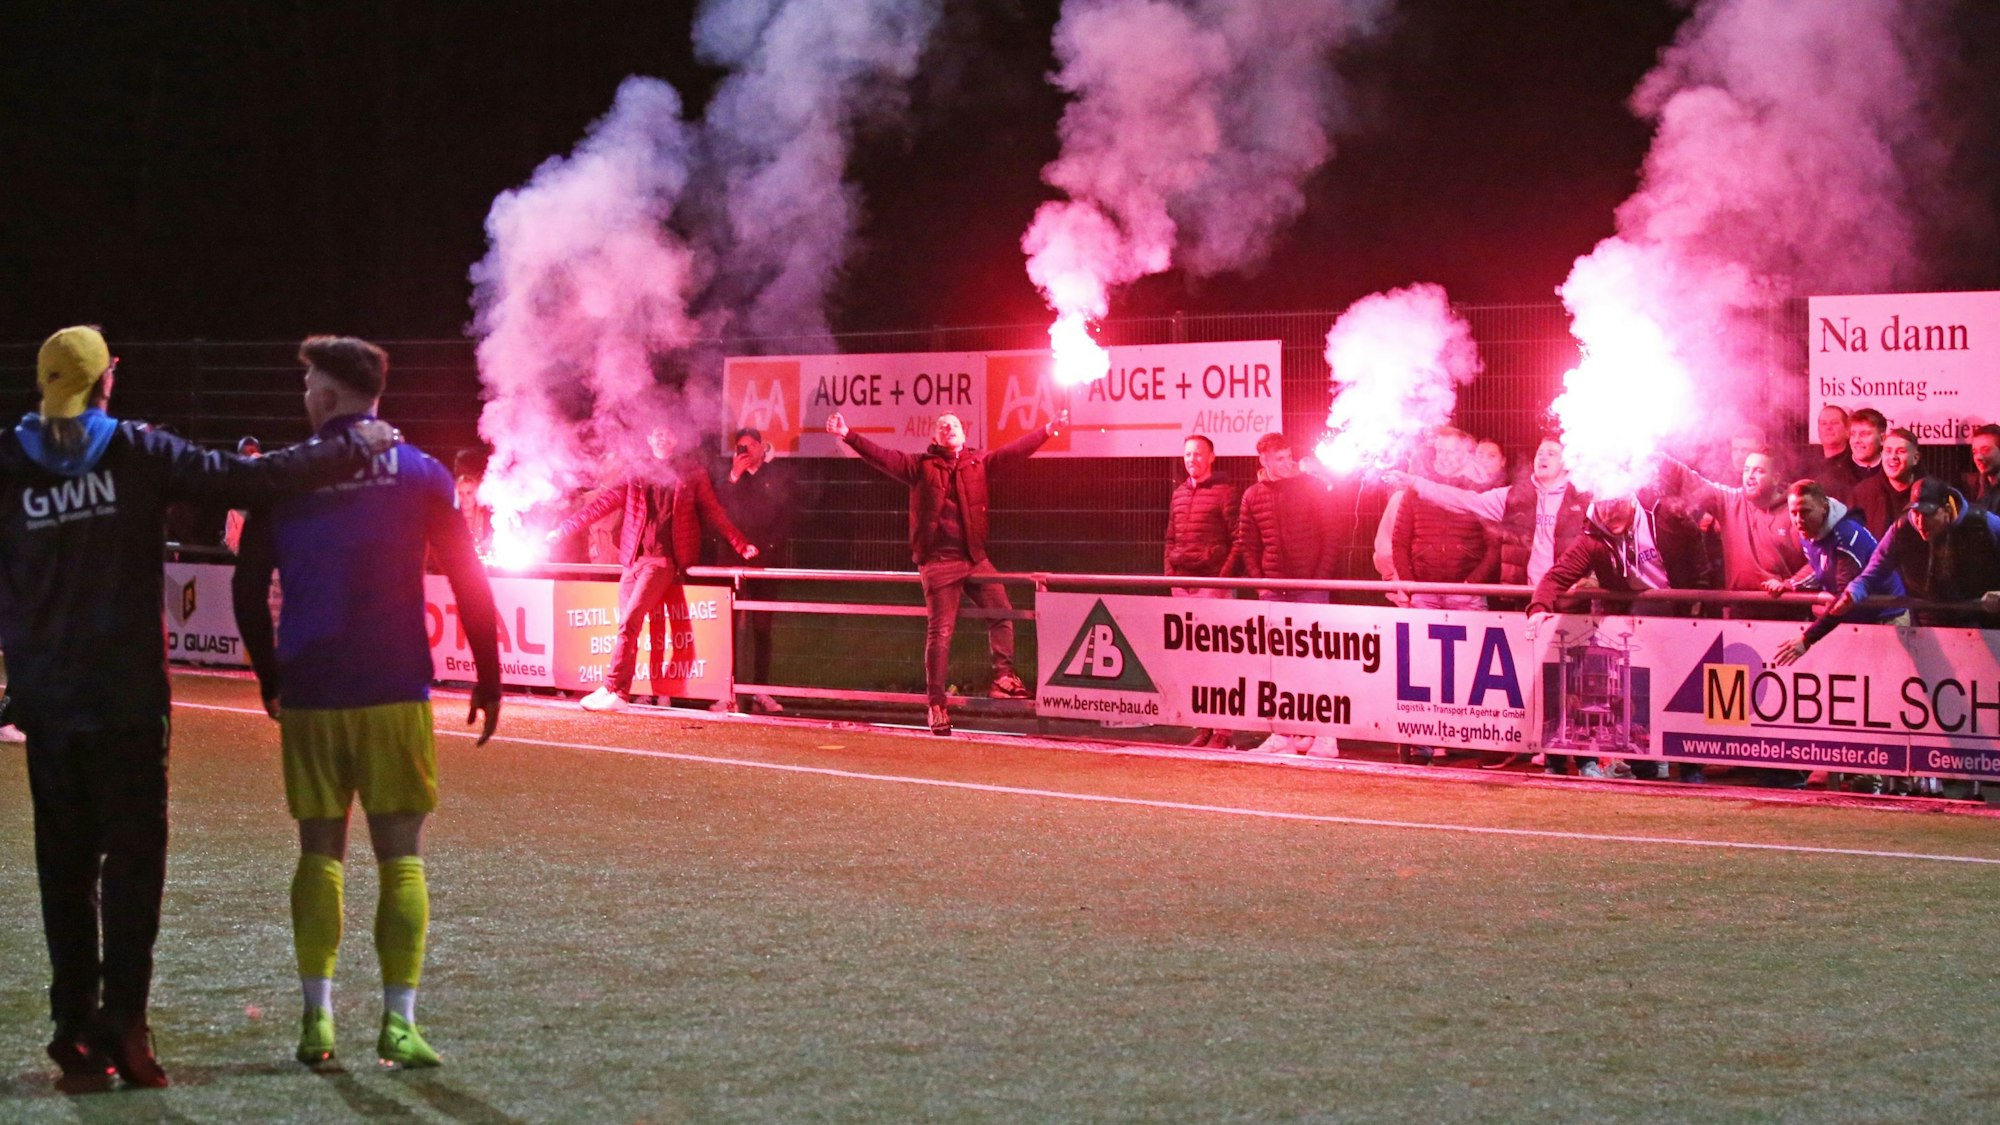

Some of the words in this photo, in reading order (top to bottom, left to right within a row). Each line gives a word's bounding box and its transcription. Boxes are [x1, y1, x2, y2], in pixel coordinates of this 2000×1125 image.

[1820, 317, 1868, 352] Na
[1880, 315, 1970, 351] dann
[814, 374, 882, 406] AUGE
[913, 373, 972, 406] OHR
[1088, 366, 1165, 401] AUGE
[1202, 364, 1272, 399] OHR
[1820, 377, 1845, 396] bis
[1851, 376, 1928, 401] Sonntag
[1191, 408, 1273, 433] Althöfer
[23, 470, 116, 518] GWN
[566, 607, 612, 628] TEXTIL
[184, 633, 239, 655] QUAST
[1164, 612, 1381, 674] Dienstleistung
[579, 664, 603, 683] 24H
[1396, 621, 1525, 709] LTA
[1043, 694, 1160, 716] www.berster-bau.de
[1191, 677, 1246, 717] und
[1257, 681, 1351, 725] Bauen
[1397, 702, 1425, 713] Logistik
[1433, 704, 1468, 716] Transport
[1470, 707, 1500, 719] Agentur
[1503, 709, 1525, 719] GmbH
[1397, 720, 1522, 742] www.lta-gmbh.de
[1683, 738, 1888, 766] www.moebel-schuster.de
[1928, 750, 2000, 772] Gewerbe
